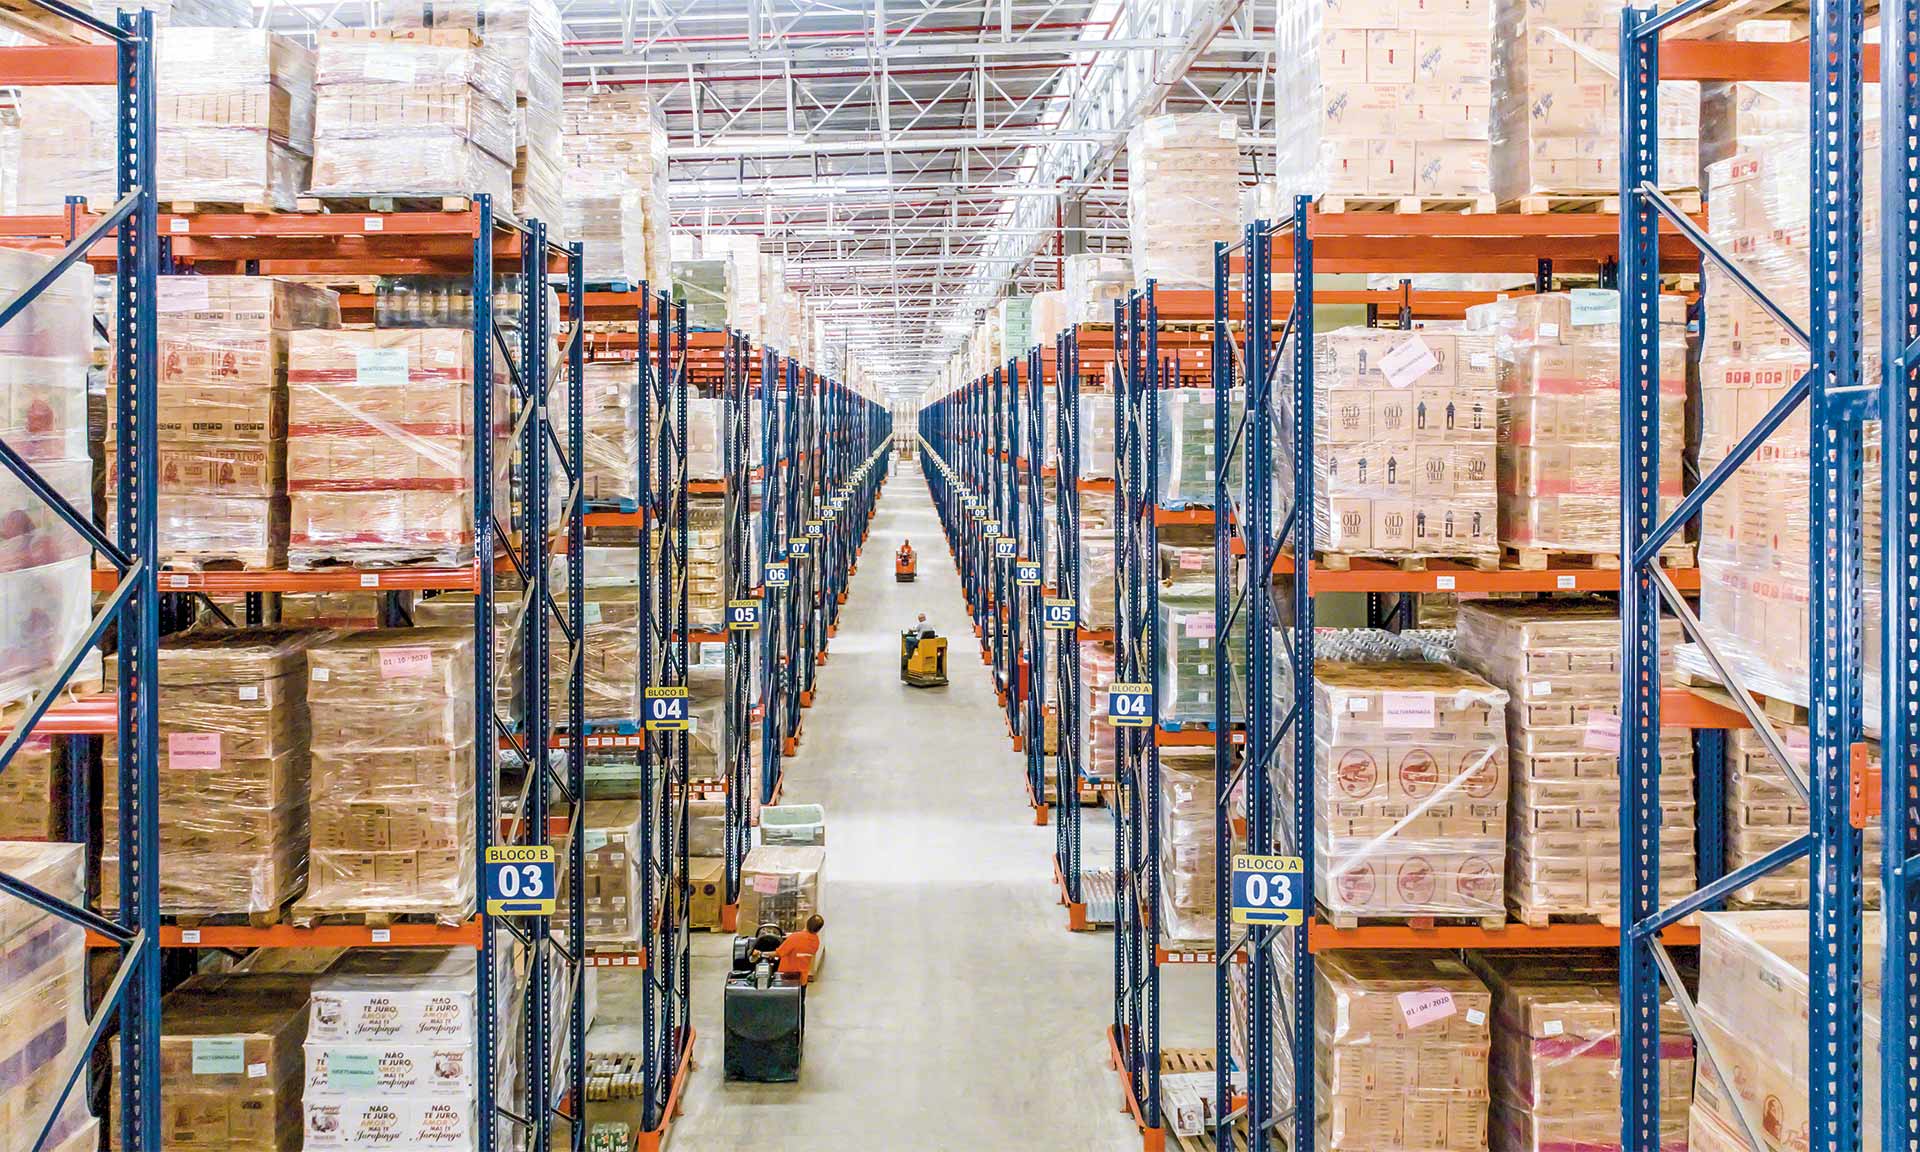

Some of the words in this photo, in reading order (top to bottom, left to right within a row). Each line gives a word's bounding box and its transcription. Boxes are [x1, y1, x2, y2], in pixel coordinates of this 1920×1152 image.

[1426, 461, 1445, 472] OLD
[823, 509, 834, 517] 09
[1343, 514, 1361, 526] OLD
[1384, 515, 1403, 527] OLD
[808, 525, 820, 533] 08
[986, 525, 998, 533] 08
[792, 543, 806, 553] 07
[999, 543, 1013, 553] 07
[769, 569, 786, 580] 06
[1020, 568, 1037, 579] 06
[734, 607, 754, 621] 05
[1051, 606, 1071, 620] 05
[653, 698, 681, 719] 04
[1116, 695, 1146, 715] 04
[491, 850, 536, 860] BLOCO
[541, 850, 548, 860] B
[1238, 858, 1284, 870] BLOCO
[1288, 860, 1298, 870] A
[499, 865, 543, 897] 03
[1246, 874, 1292, 907] 03
